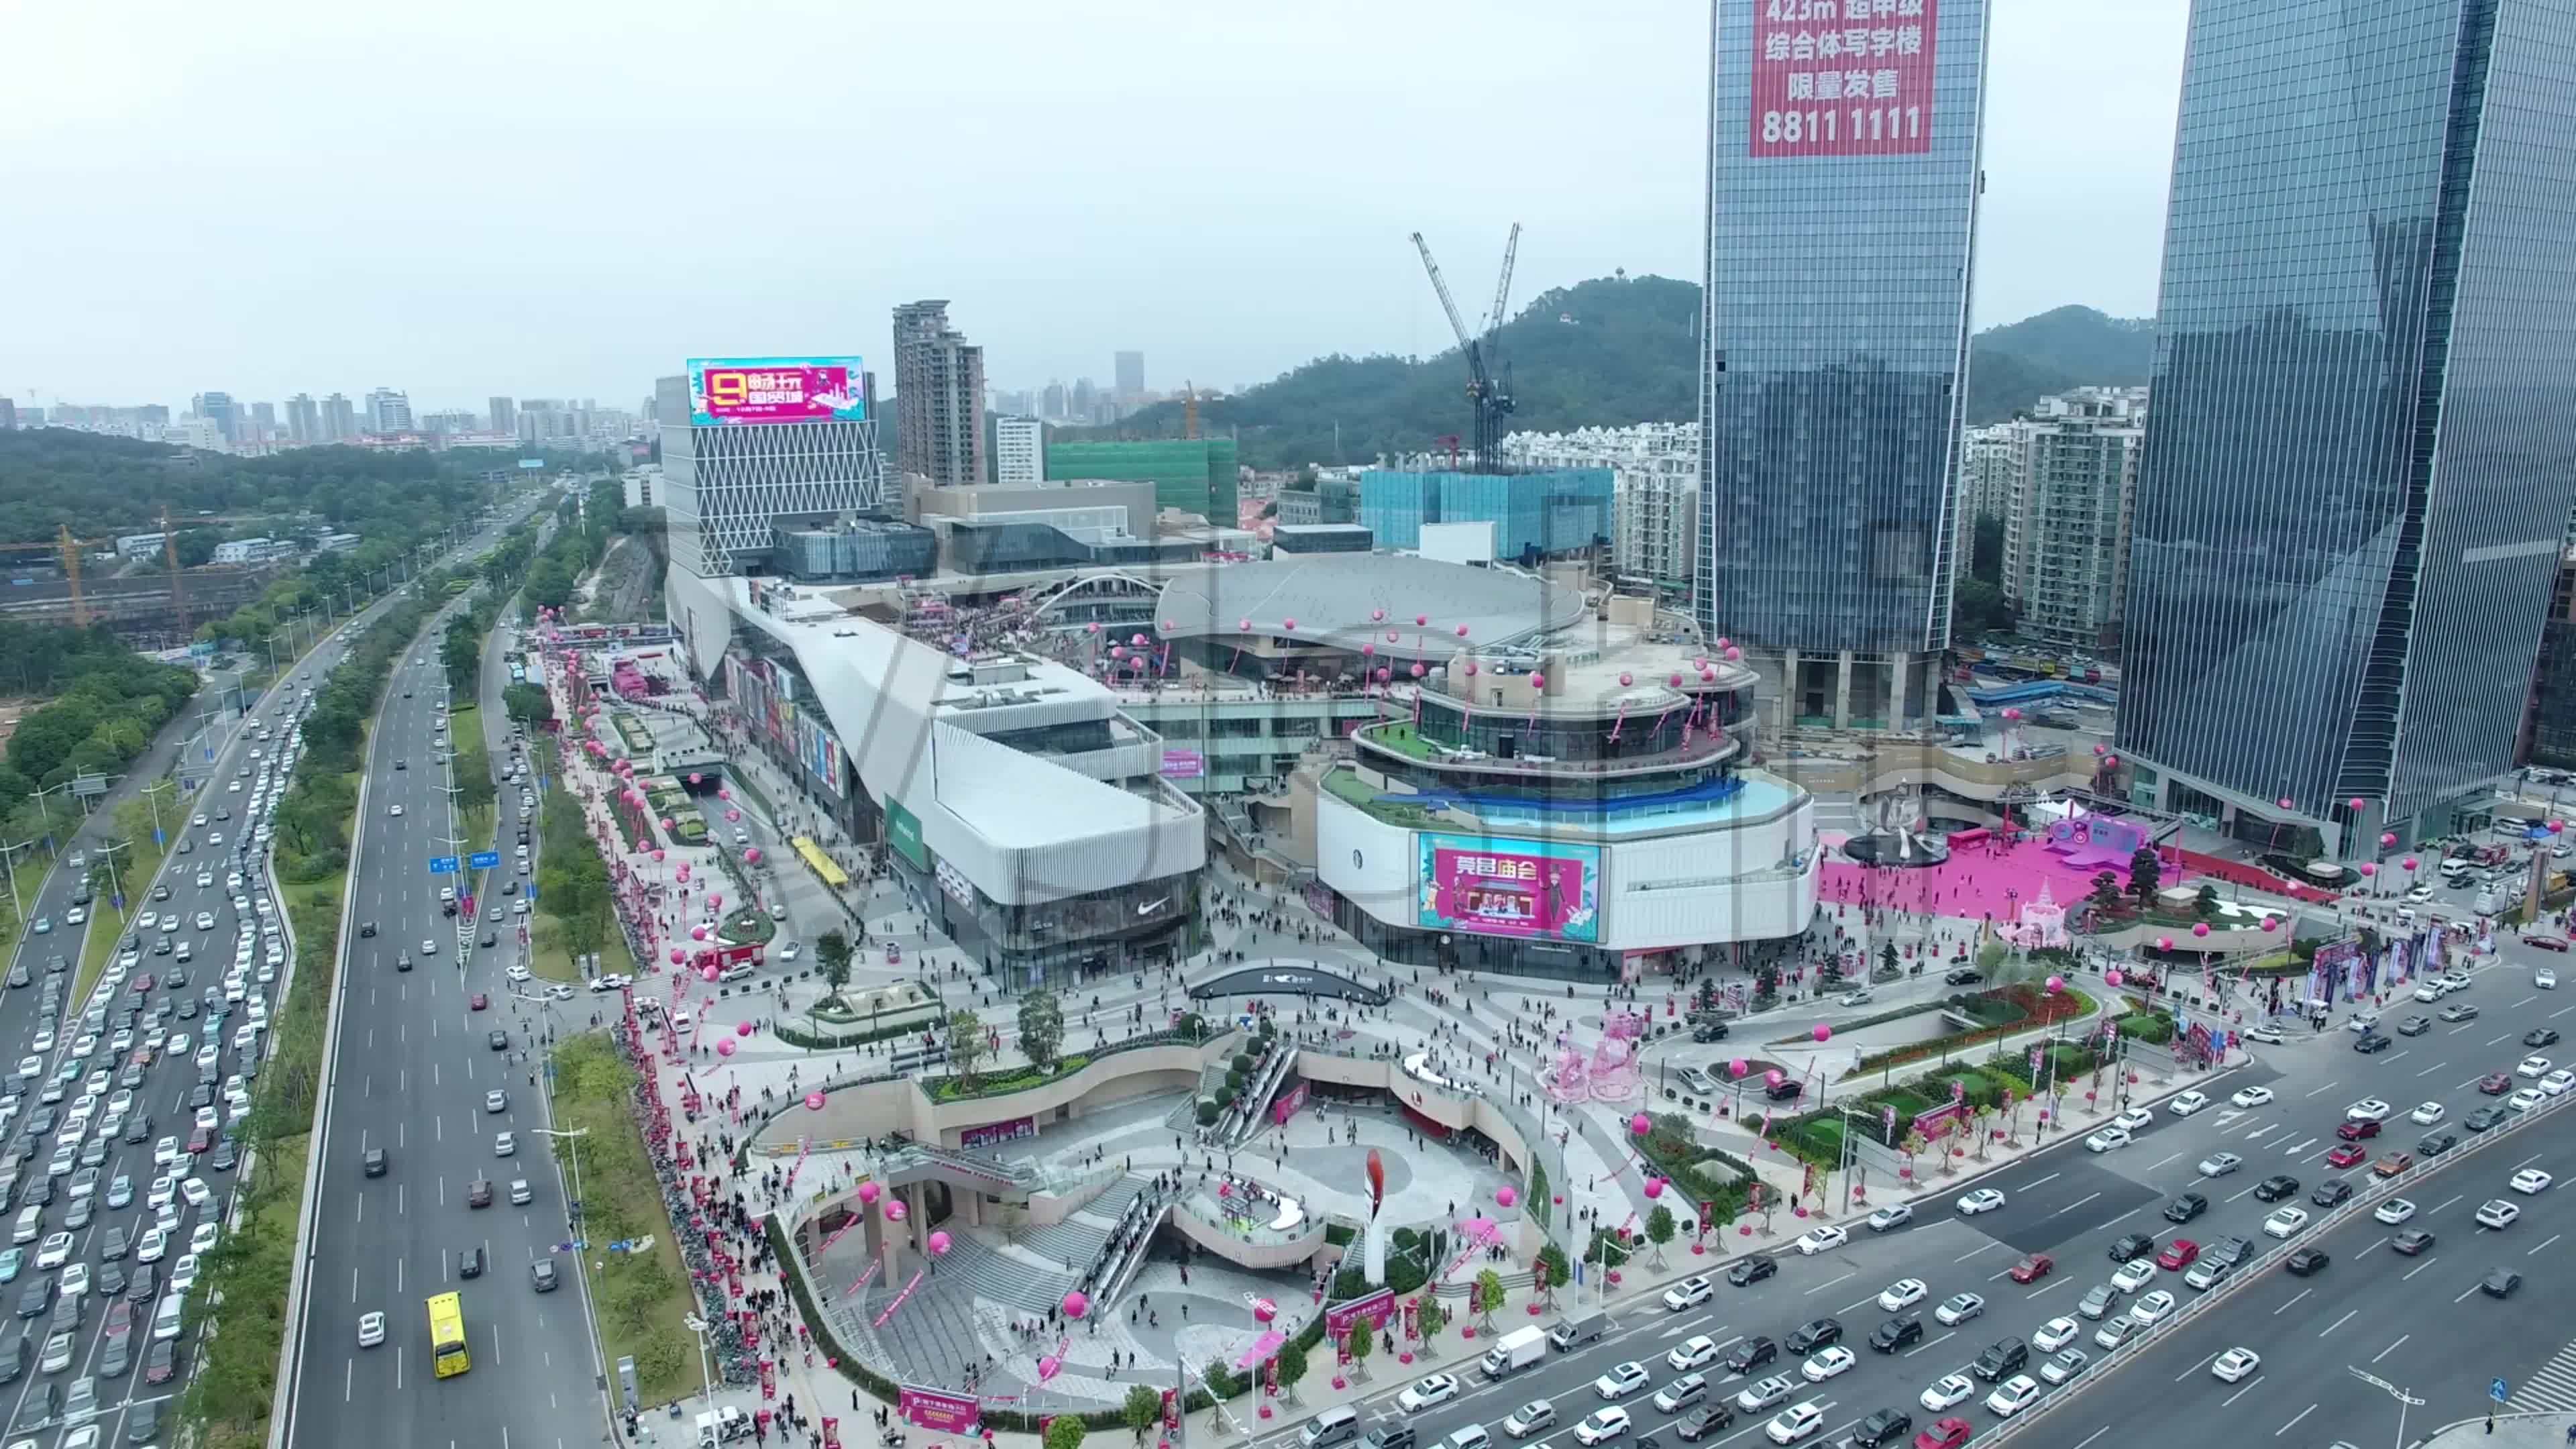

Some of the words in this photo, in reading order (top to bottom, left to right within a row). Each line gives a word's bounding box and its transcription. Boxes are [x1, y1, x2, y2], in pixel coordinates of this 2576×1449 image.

[1765, 25, 1923, 61] 综合体写字楼
[1787, 69, 1898, 101] 限量发售
[1762, 109, 1837, 143] 8811
[1851, 106, 1921, 141] 1111
